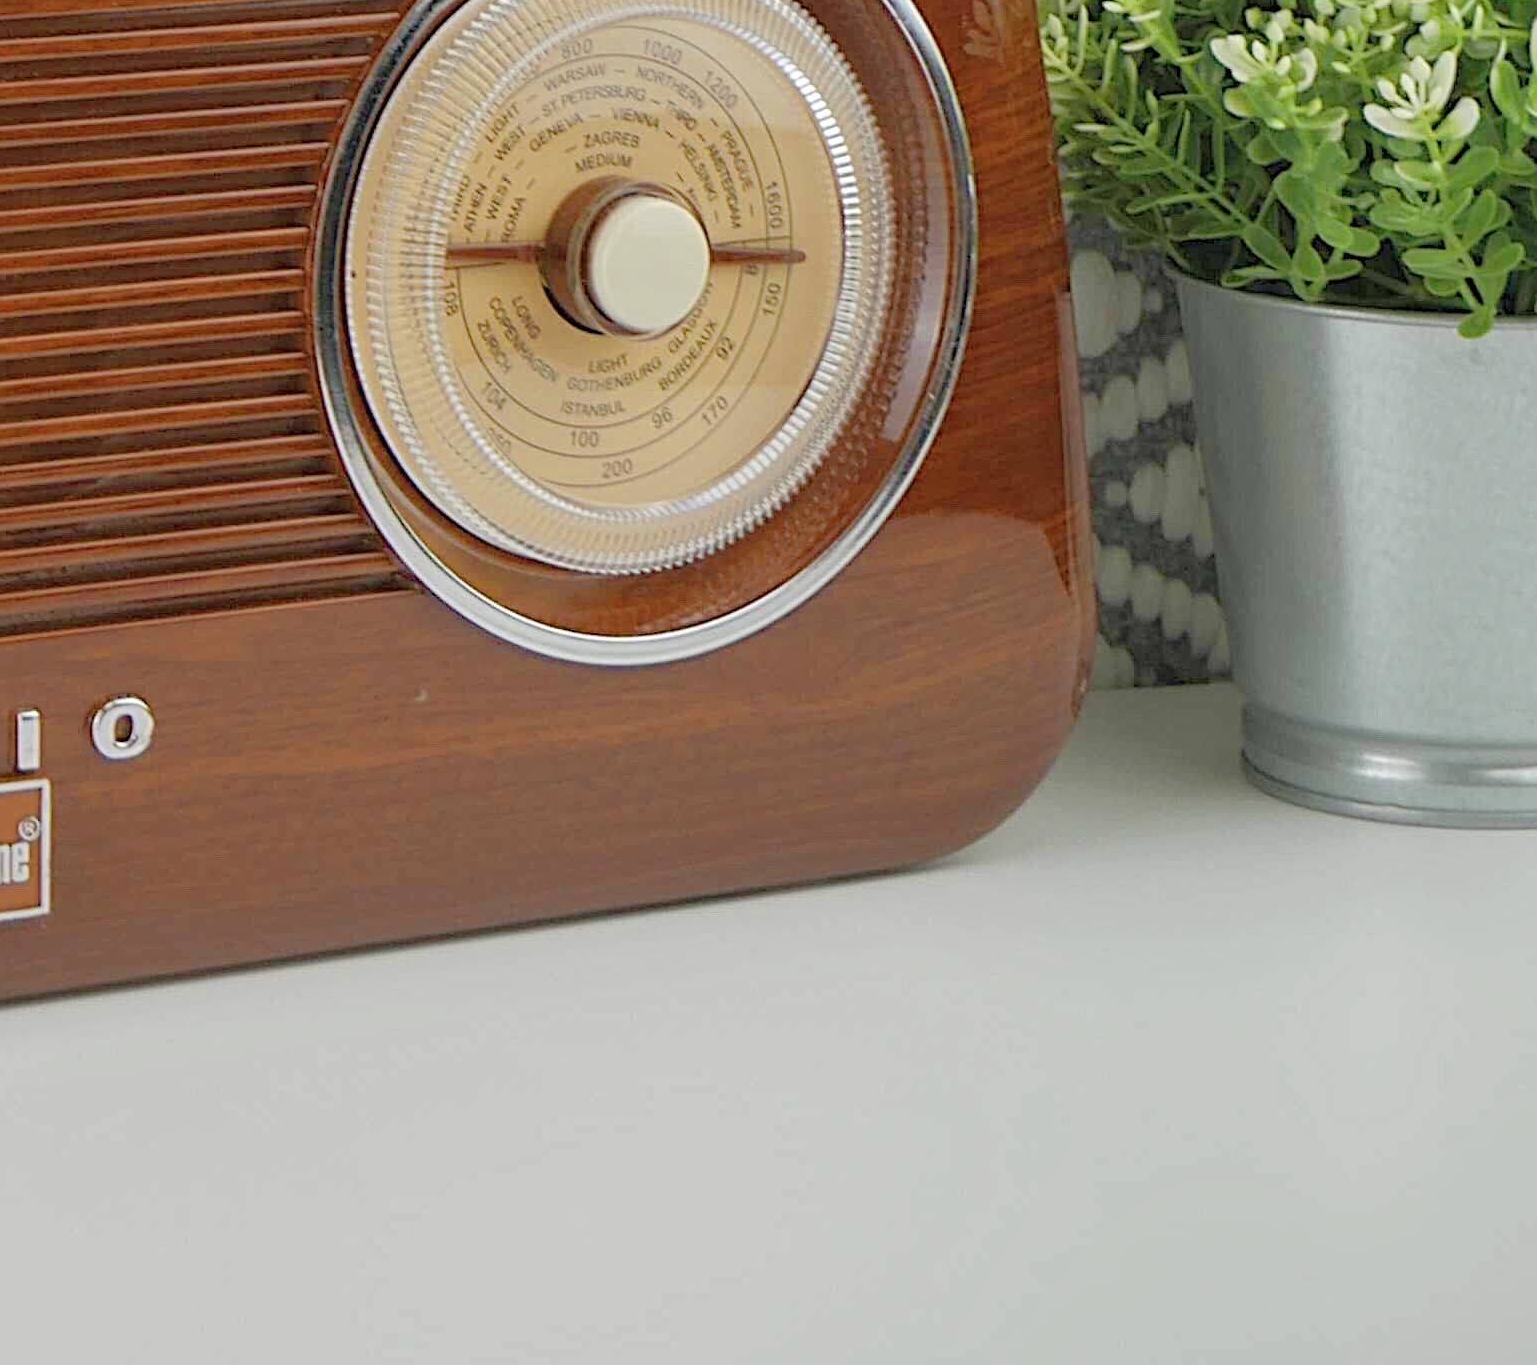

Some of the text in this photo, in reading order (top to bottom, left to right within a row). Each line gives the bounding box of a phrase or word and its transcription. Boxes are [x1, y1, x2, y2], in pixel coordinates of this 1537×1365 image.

[485, 101, 522, 145] LIGHT
[542, 61, 607, 92] WARSAW
[636, 65, 706, 111] NORTHERN
[494, 123, 529, 162] WEST
[582, 129, 641, 150] ZAGREB
[643, 37, 683, 66] 1000
[703, 70, 739, 109] 1200
[765, 180, 785, 230] 1600
[484, 172, 513, 221] WEST
[528, 111, 584, 153] GENEVA
[611, 107, 661, 129] VIENNA
[573, 152, 634, 174] MEDIUM
[511, 294, 543, 341] LONG
[588, 353, 630, 375] LIGHT
[566, 355, 664, 393] GOTHENBURG
[657, 319, 720, 393] BORDEAUX
[481, 380, 509, 412] 104
[569, 430, 601, 449] 100
[651, 406, 675, 430] 96
[715, 336, 737, 362] 92
[561, 399, 627, 419] ISTANBUL
[601, 458, 634, 480] 200
[700, 395, 730, 427] 170
[762, 281, 782, 318] 150
